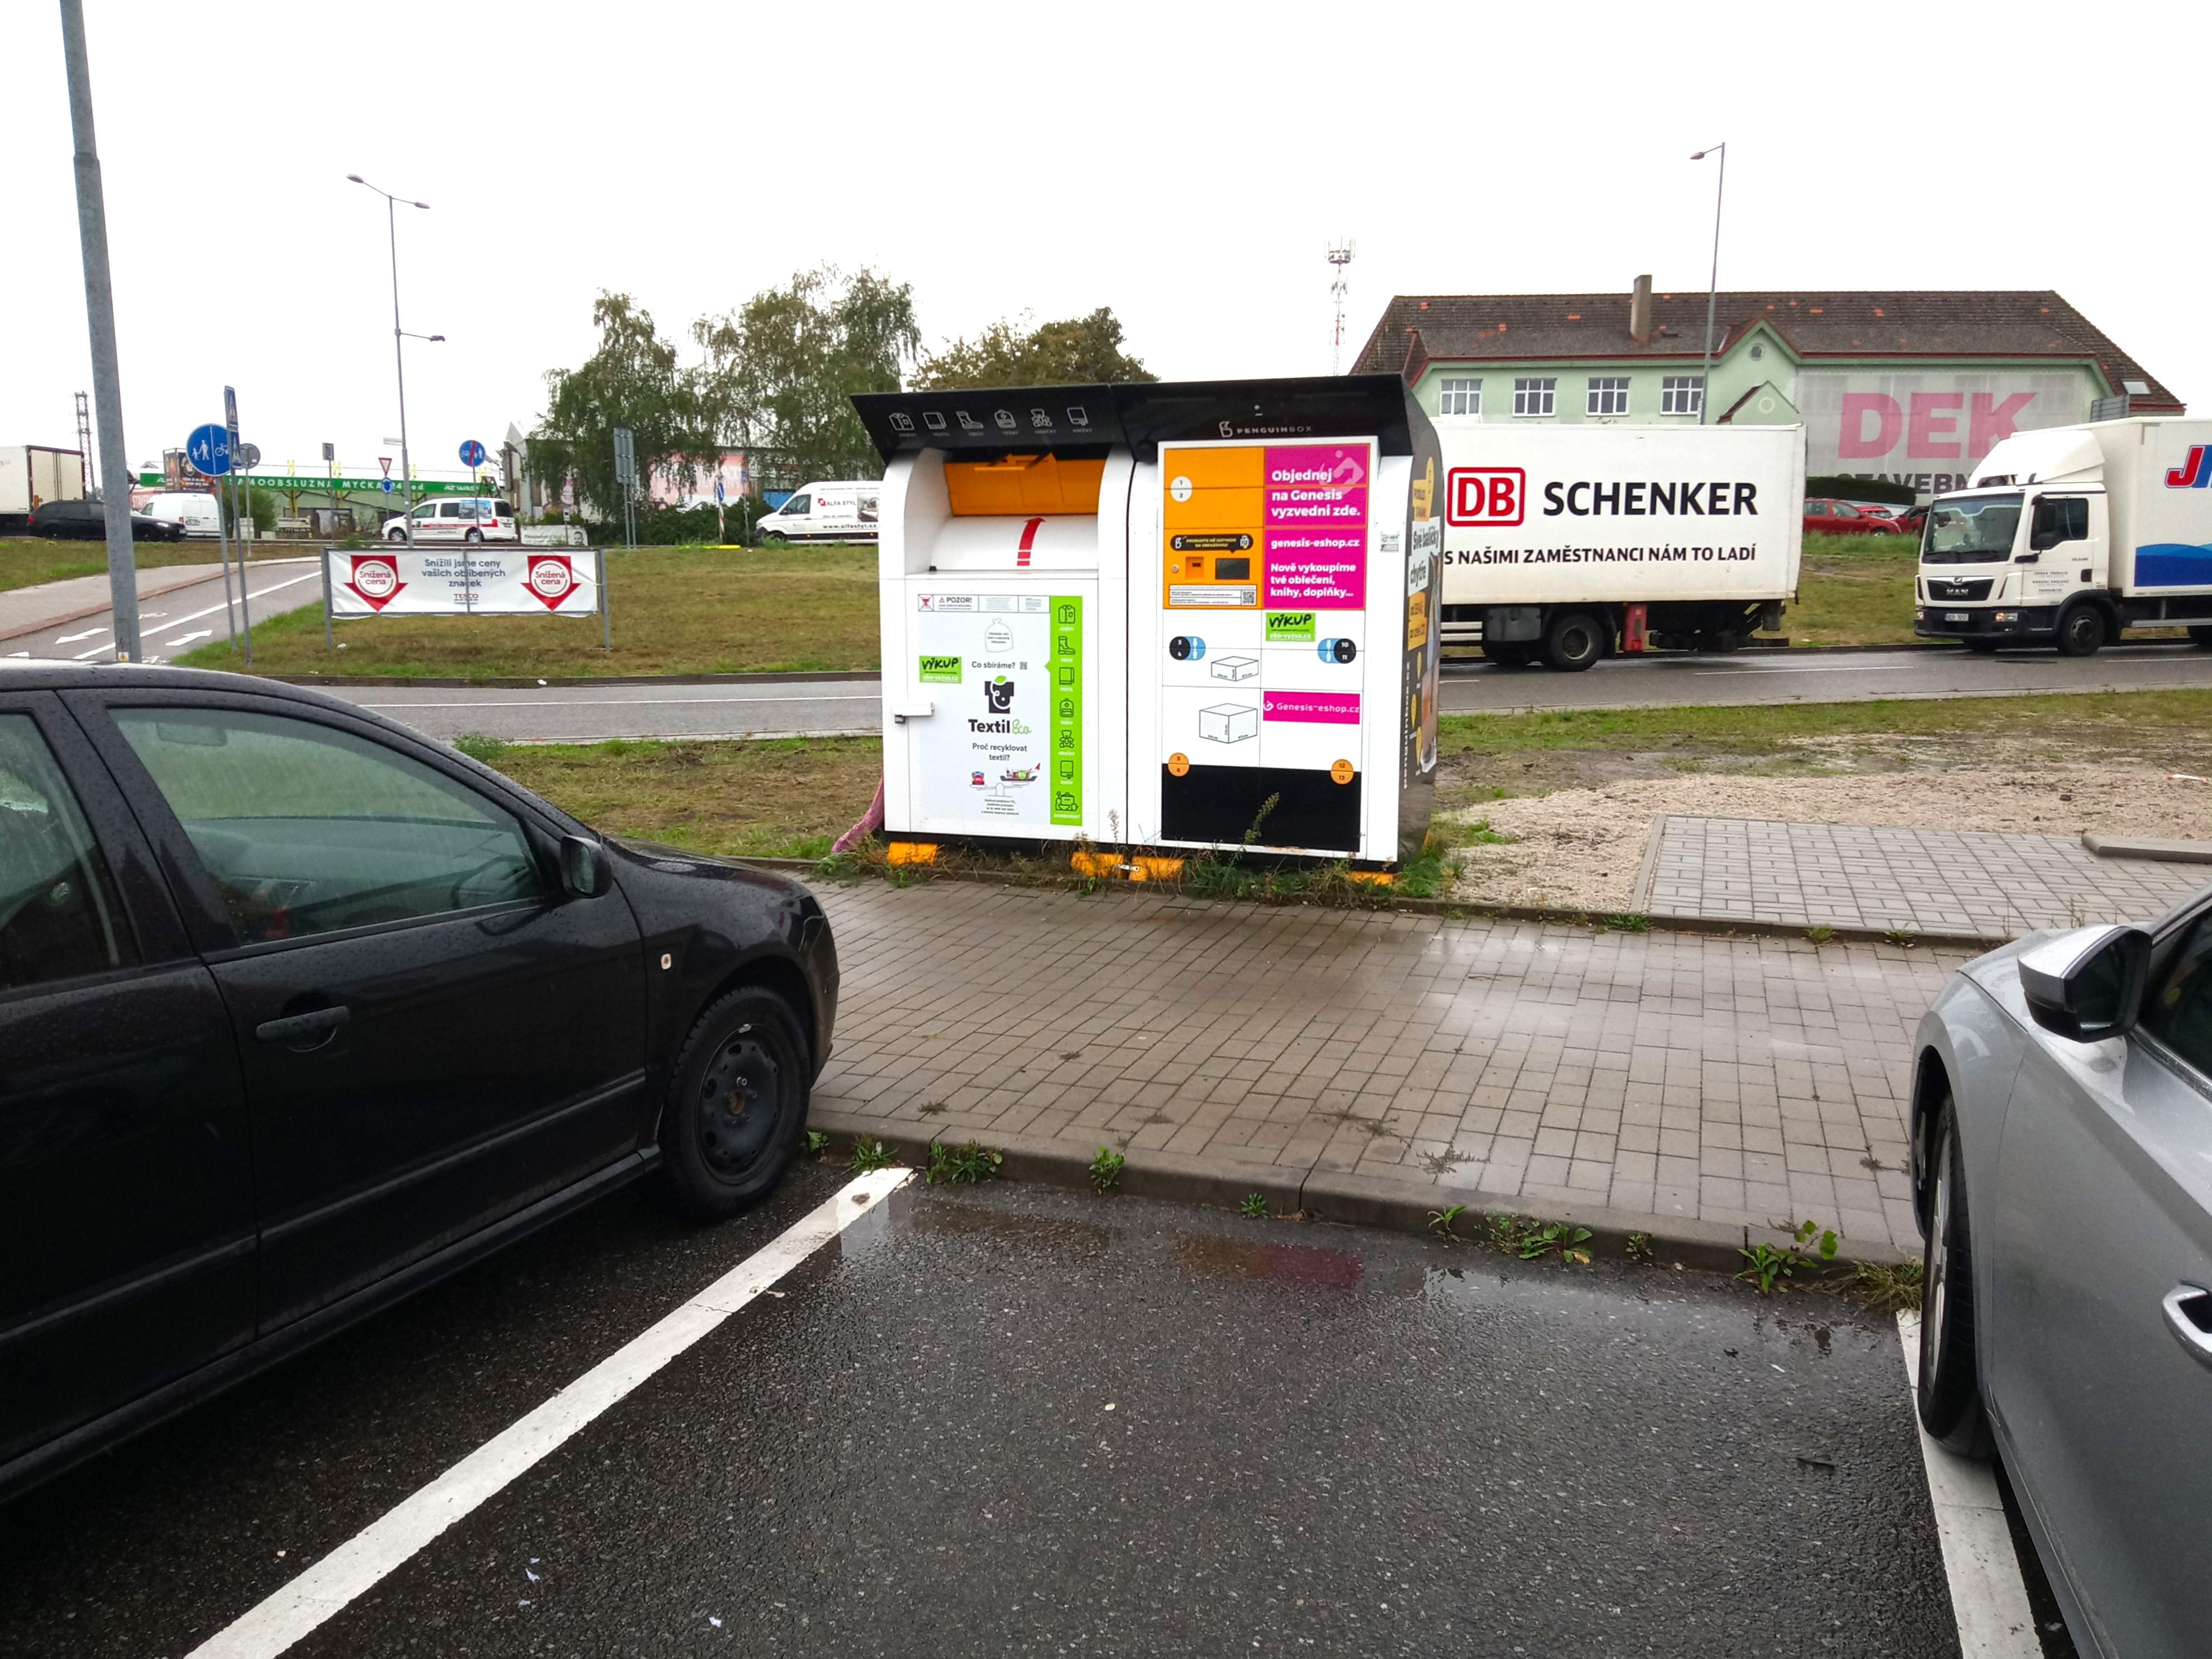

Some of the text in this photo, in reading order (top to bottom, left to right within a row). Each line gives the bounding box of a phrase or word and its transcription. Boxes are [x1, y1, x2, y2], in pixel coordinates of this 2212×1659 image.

[1236, 425, 1313, 435] PENGUINBOX
[1838, 393, 2038, 459] DEK
[1271, 468, 1332, 483] Objednej
[1271, 489, 1342, 501] na Genesis
[1456, 477, 1515, 517] DB
[1543, 482, 1758, 516] SCHENKER
[1271, 504, 1361, 519] vyzvedni zde.
[1271, 538, 1360, 550] genesis-eshop.cz
[1444, 544, 1756, 565] S NAŠIMI ZAMĚSTNANCI NÁM TO LADÍ
[425, 559, 452, 567] Snížili
[479, 560, 500, 569] ceny
[1298, 562, 1356, 574] vykoupíme
[359, 570, 392, 579] Snížená
[422, 569, 452, 577] vašich
[535, 570, 565, 579] Snížená
[1271, 575, 1335, 586] tvé oblečení,
[1270, 587, 1302, 599] knihy,
[1269, 614, 1312, 628] VÝKUP
[922, 657, 959, 670] VÝKUP
[984, 661, 1016, 669] sbíráme?
[1276, 701, 1360, 713] Genesis-eshop.cz
[968, 719, 1032, 735] Textil Eco
[990, 743, 1027, 753] recyklovat
